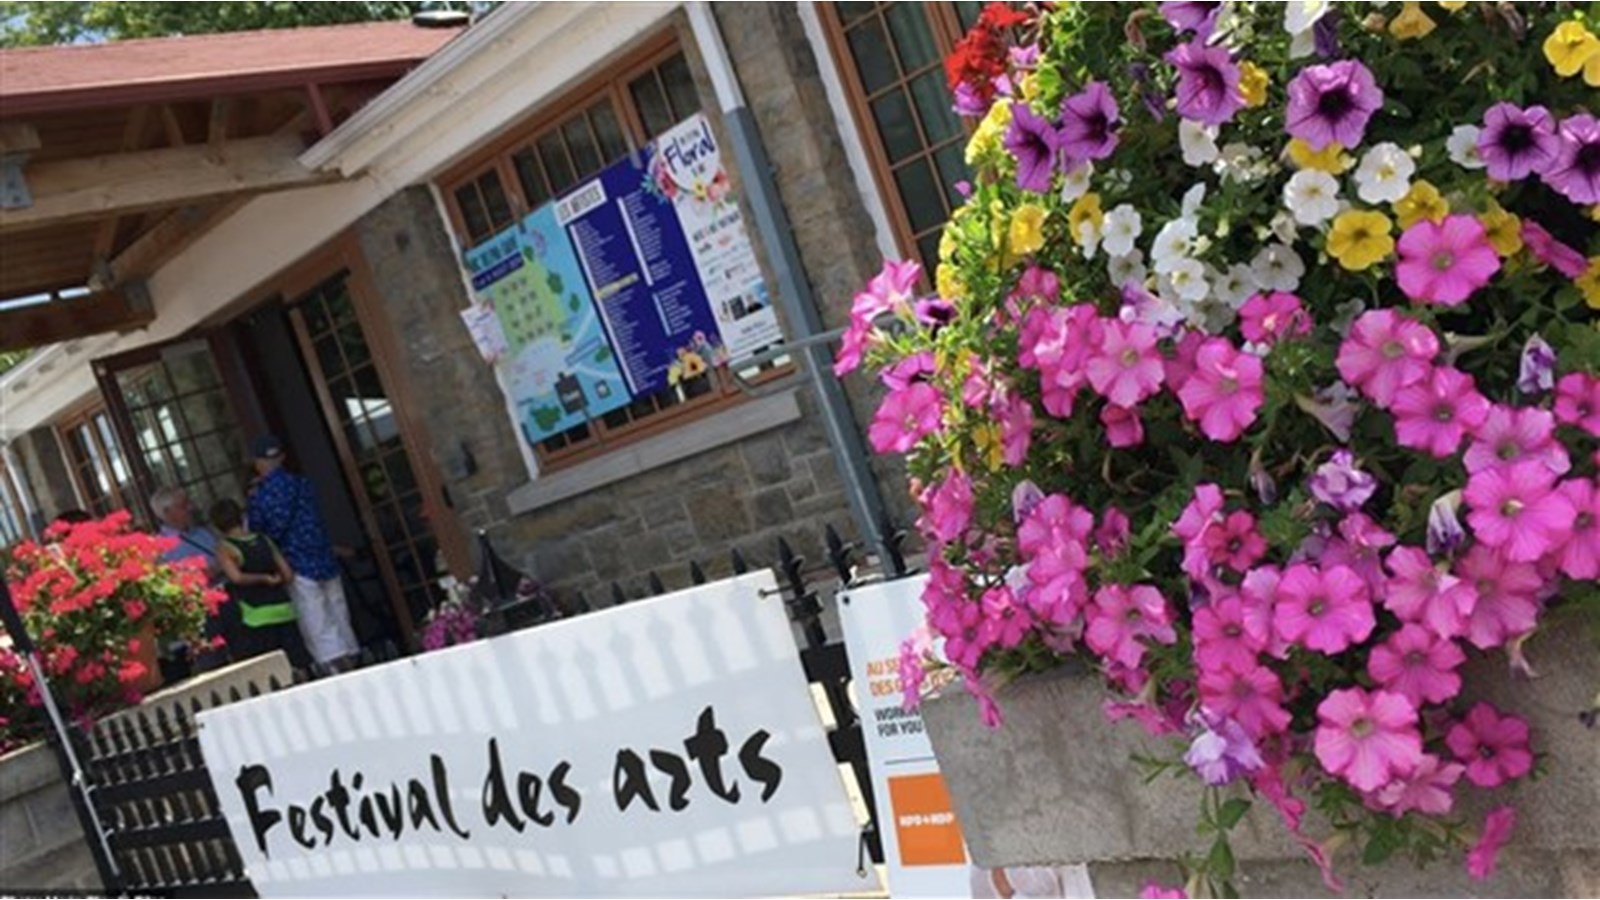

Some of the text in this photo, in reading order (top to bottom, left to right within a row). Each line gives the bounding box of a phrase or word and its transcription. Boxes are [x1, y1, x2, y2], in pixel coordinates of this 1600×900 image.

[664, 119, 716, 174] Floral
[875, 706, 920, 721] WORKIN
[877, 720, 922, 737] FOR YOU
[236, 706, 783, 855] Festival des arts
